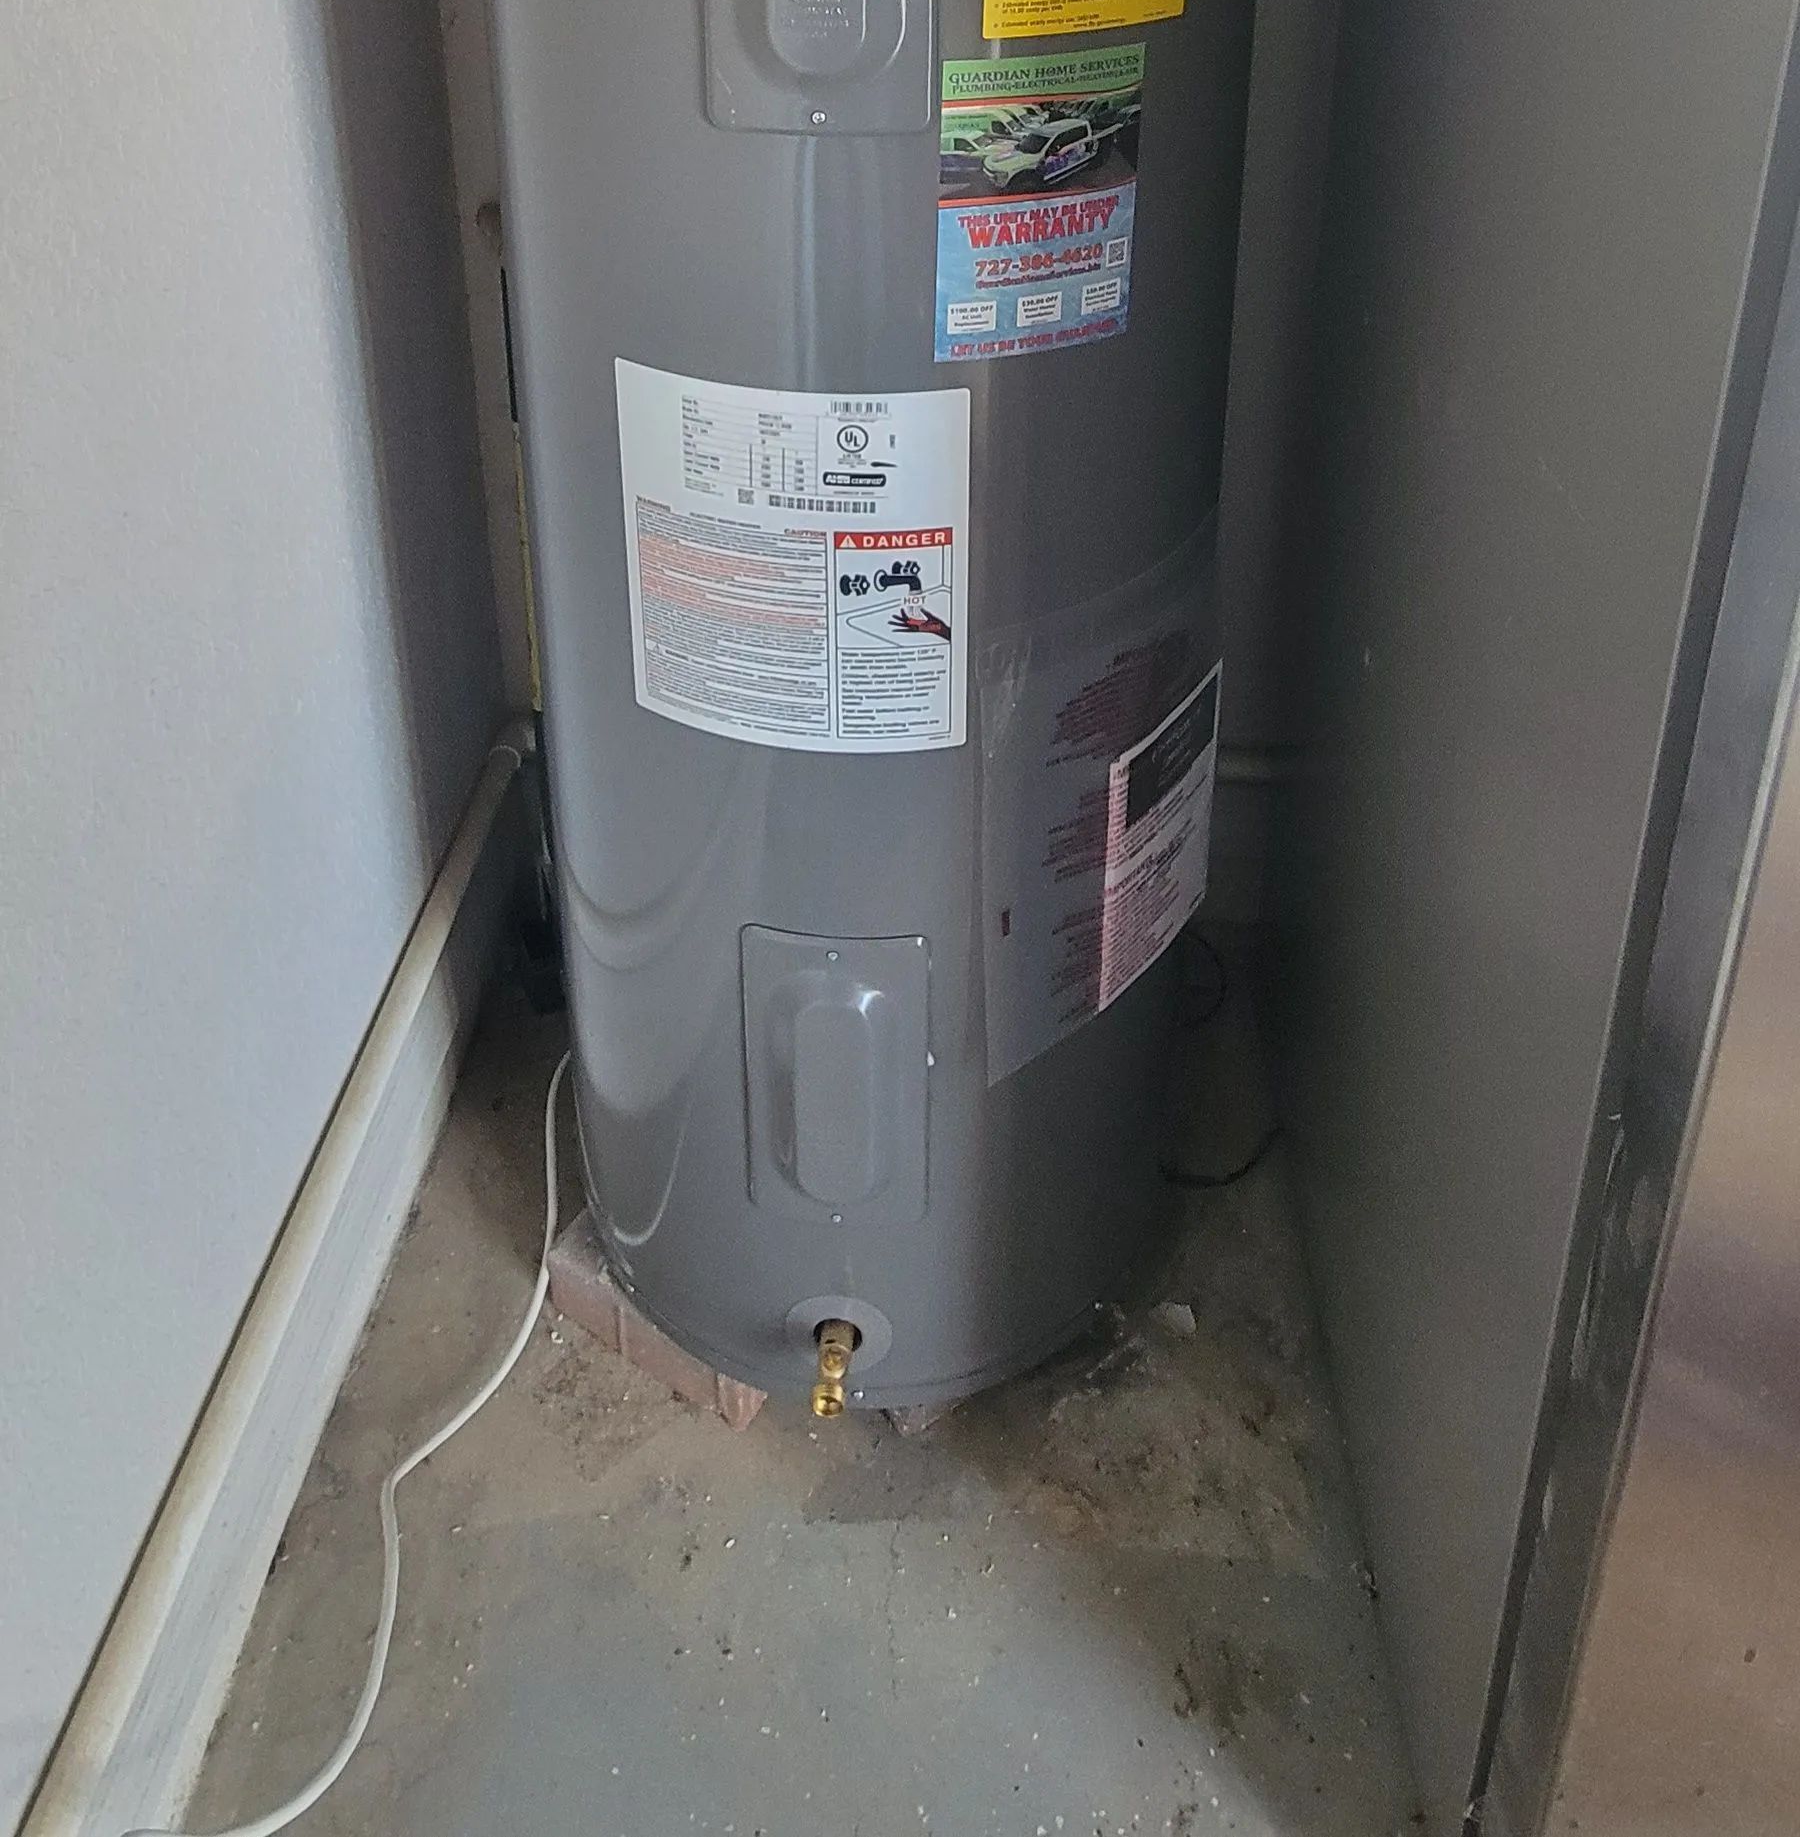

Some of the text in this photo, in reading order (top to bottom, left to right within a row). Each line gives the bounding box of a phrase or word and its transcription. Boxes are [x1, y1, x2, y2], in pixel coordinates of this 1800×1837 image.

[949, 54, 1140, 85] GUARDIAN HOME SERVICES
[958, 215, 990, 228] THIS
[1030, 206, 1059, 220] MAY
[968, 206, 1115, 249] WARRANTY
[845, 431, 860, 447] UL
[863, 531, 945, 547] DANGER
[903, 596, 926, 604] HOT
